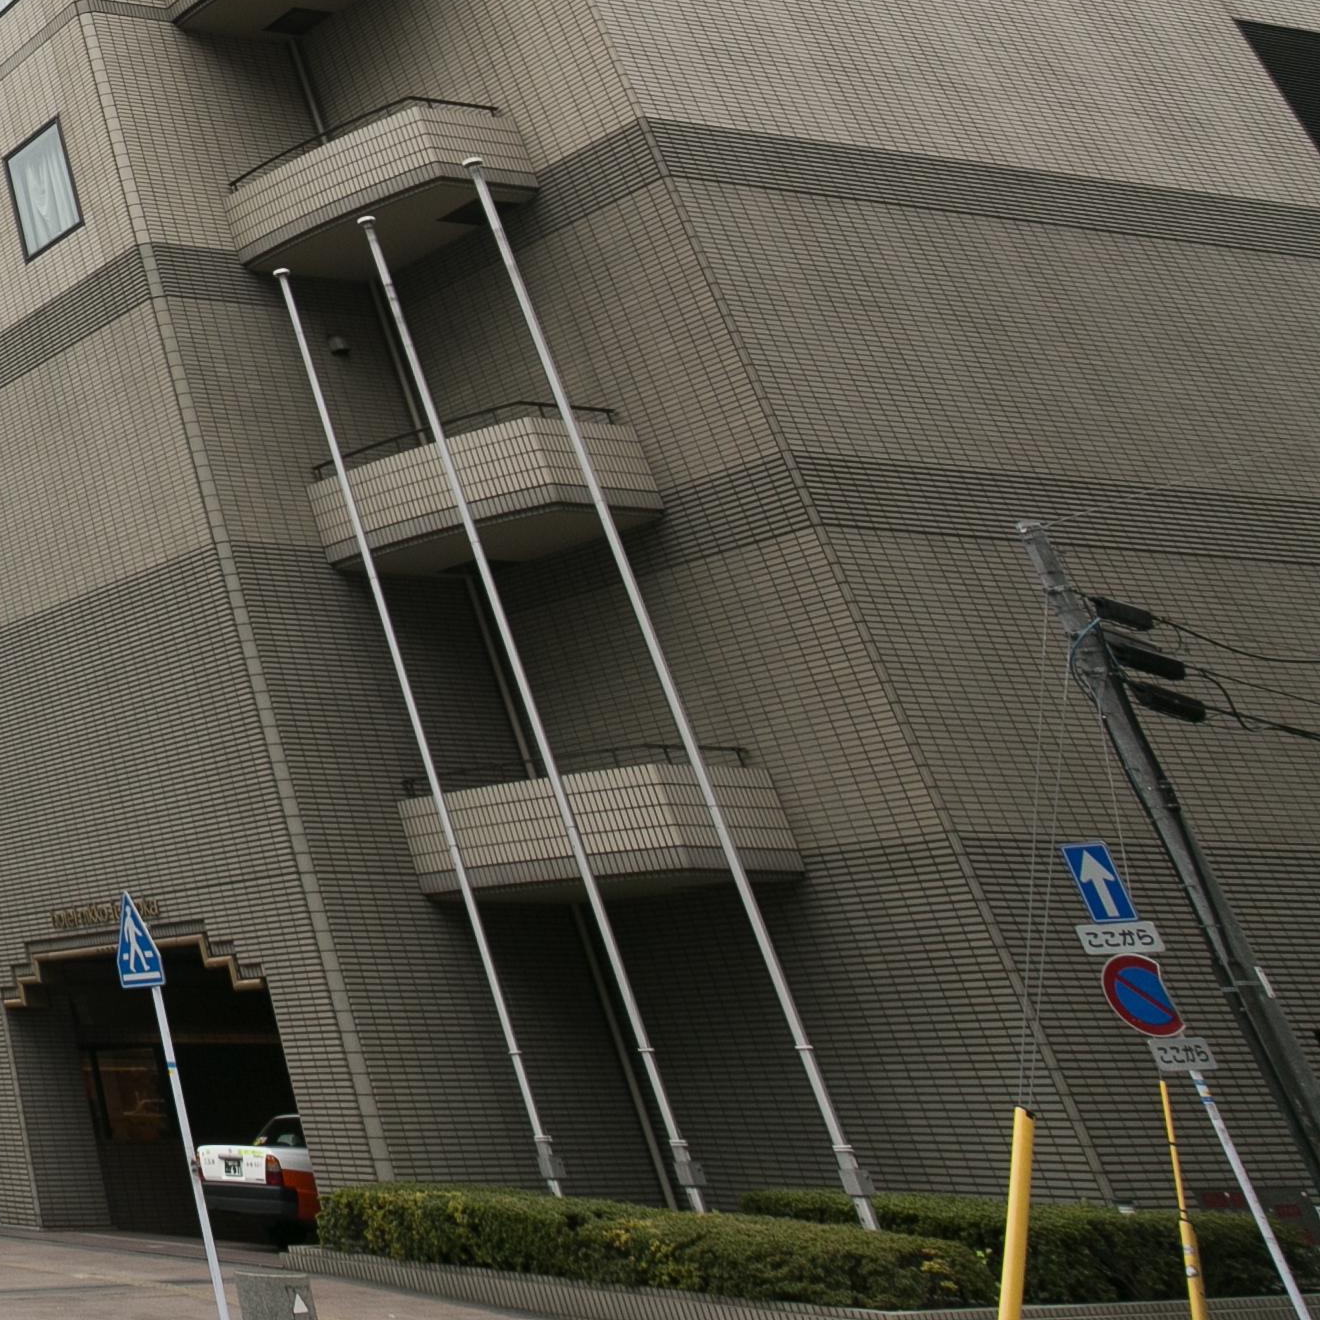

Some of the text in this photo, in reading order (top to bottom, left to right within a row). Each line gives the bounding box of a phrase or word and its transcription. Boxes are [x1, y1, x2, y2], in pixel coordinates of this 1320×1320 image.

[1085, 929, 1155, 948] ここから
[1157, 1044, 1210, 1064] ここから
